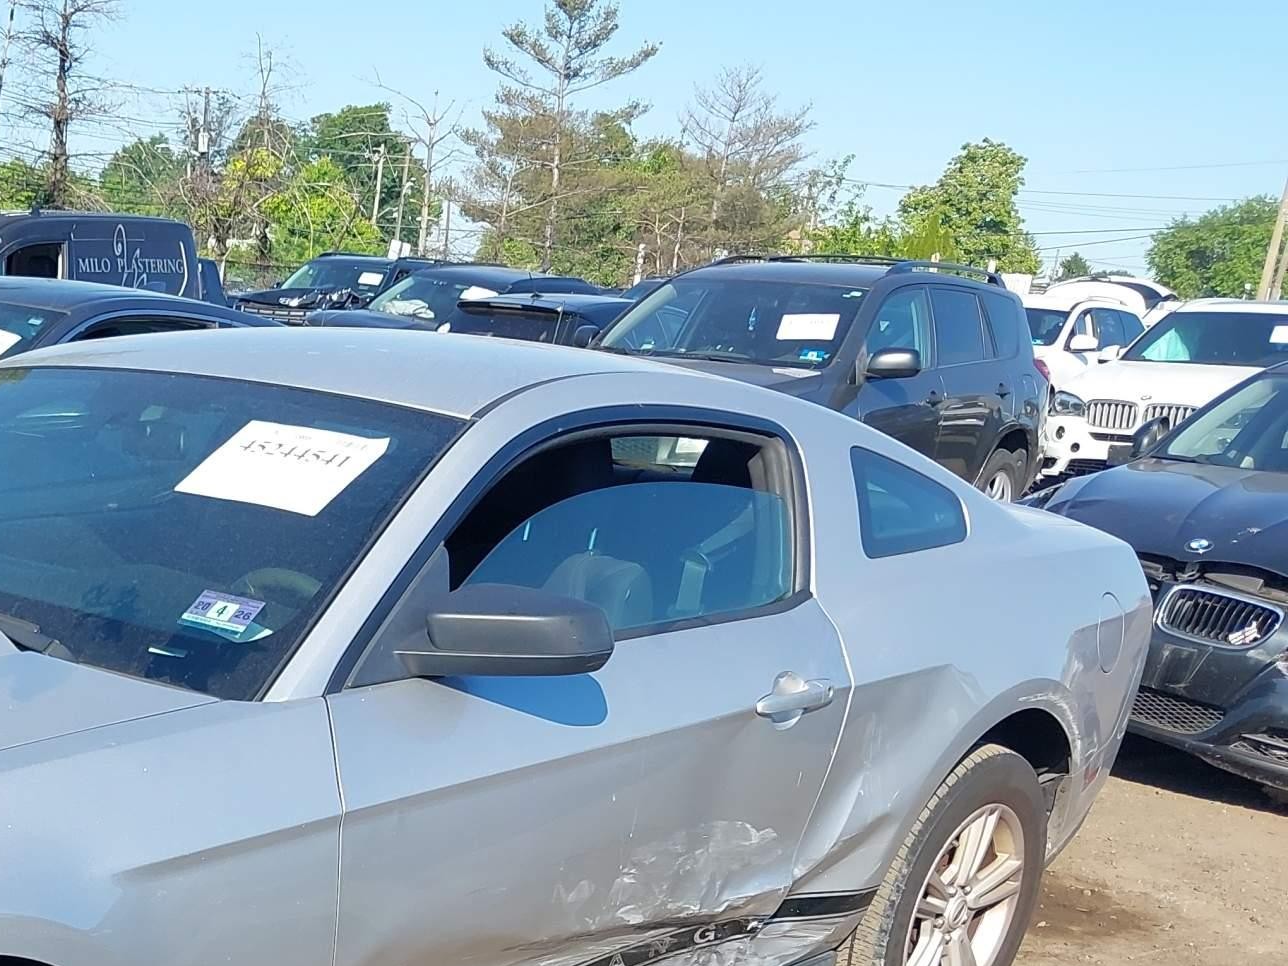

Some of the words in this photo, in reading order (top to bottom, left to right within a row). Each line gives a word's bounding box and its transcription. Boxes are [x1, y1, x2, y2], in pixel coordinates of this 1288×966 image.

[78, 258, 111, 273] MILO
[117, 257, 184, 274] PLASTERING
[194, 600, 212, 611] 20
[216, 604, 228, 617] 4
[235, 610, 251, 621] 26
